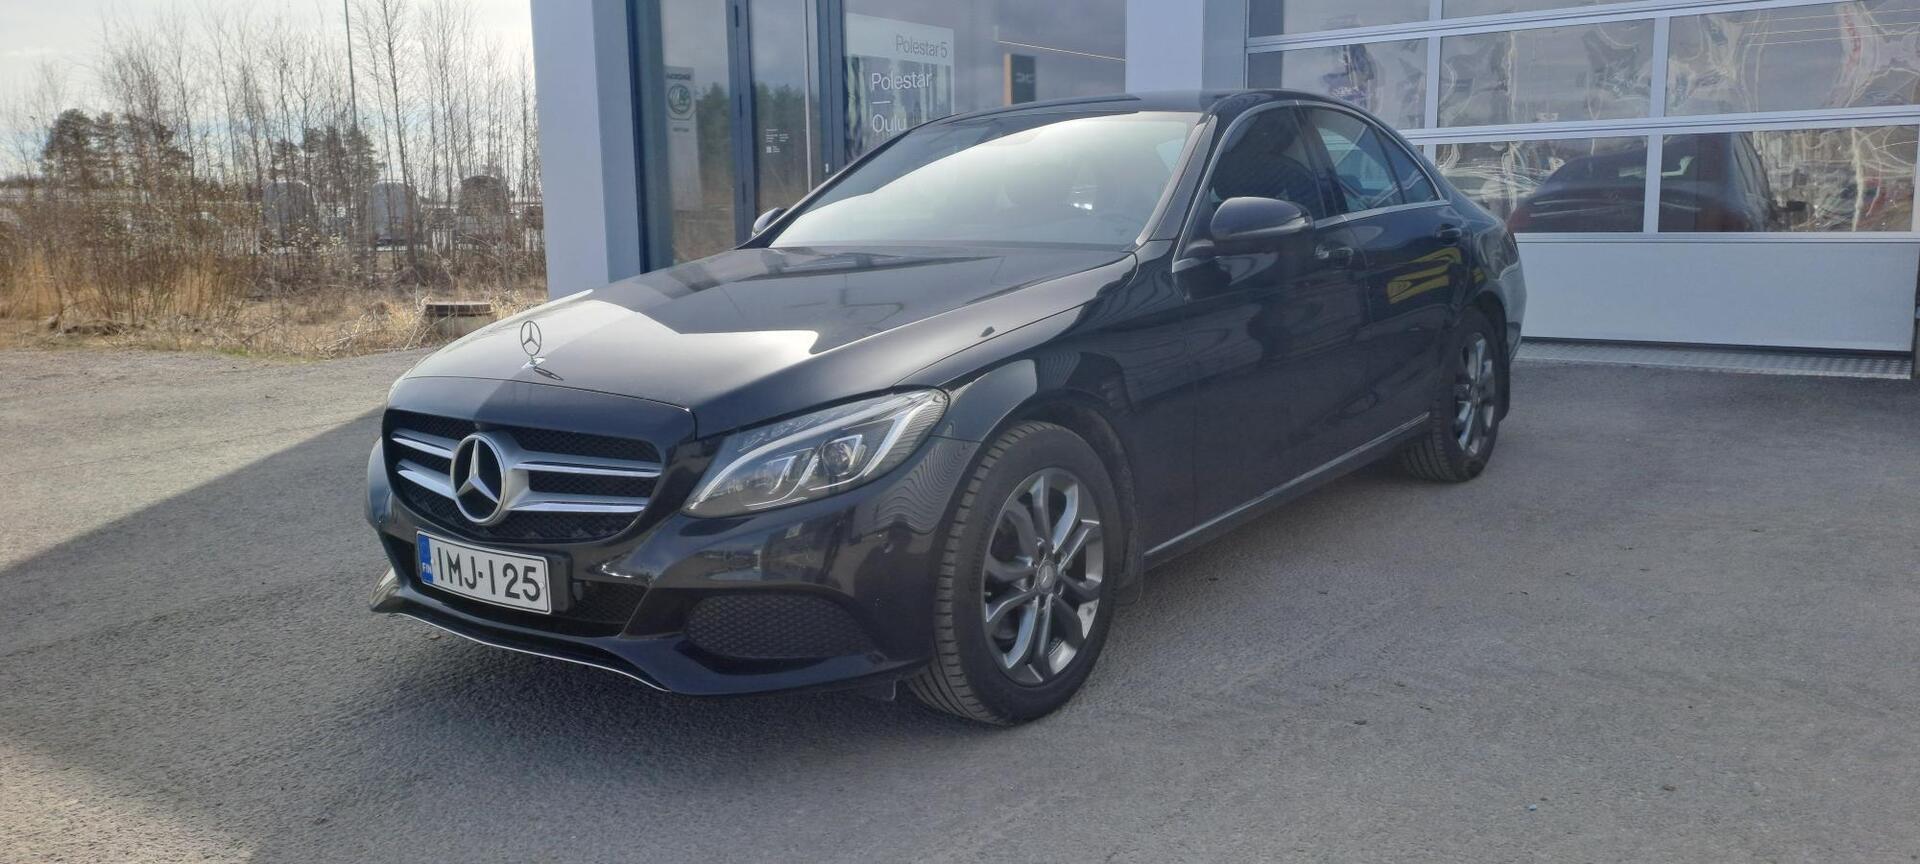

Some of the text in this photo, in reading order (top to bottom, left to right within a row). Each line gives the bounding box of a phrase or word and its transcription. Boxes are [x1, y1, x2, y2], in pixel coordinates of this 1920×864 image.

[895, 34, 948, 58] Polestar 5
[871, 70, 932, 92] Polestar
[872, 113, 907, 133] Oulu
[437, 547, 541, 601] IMJ-125
